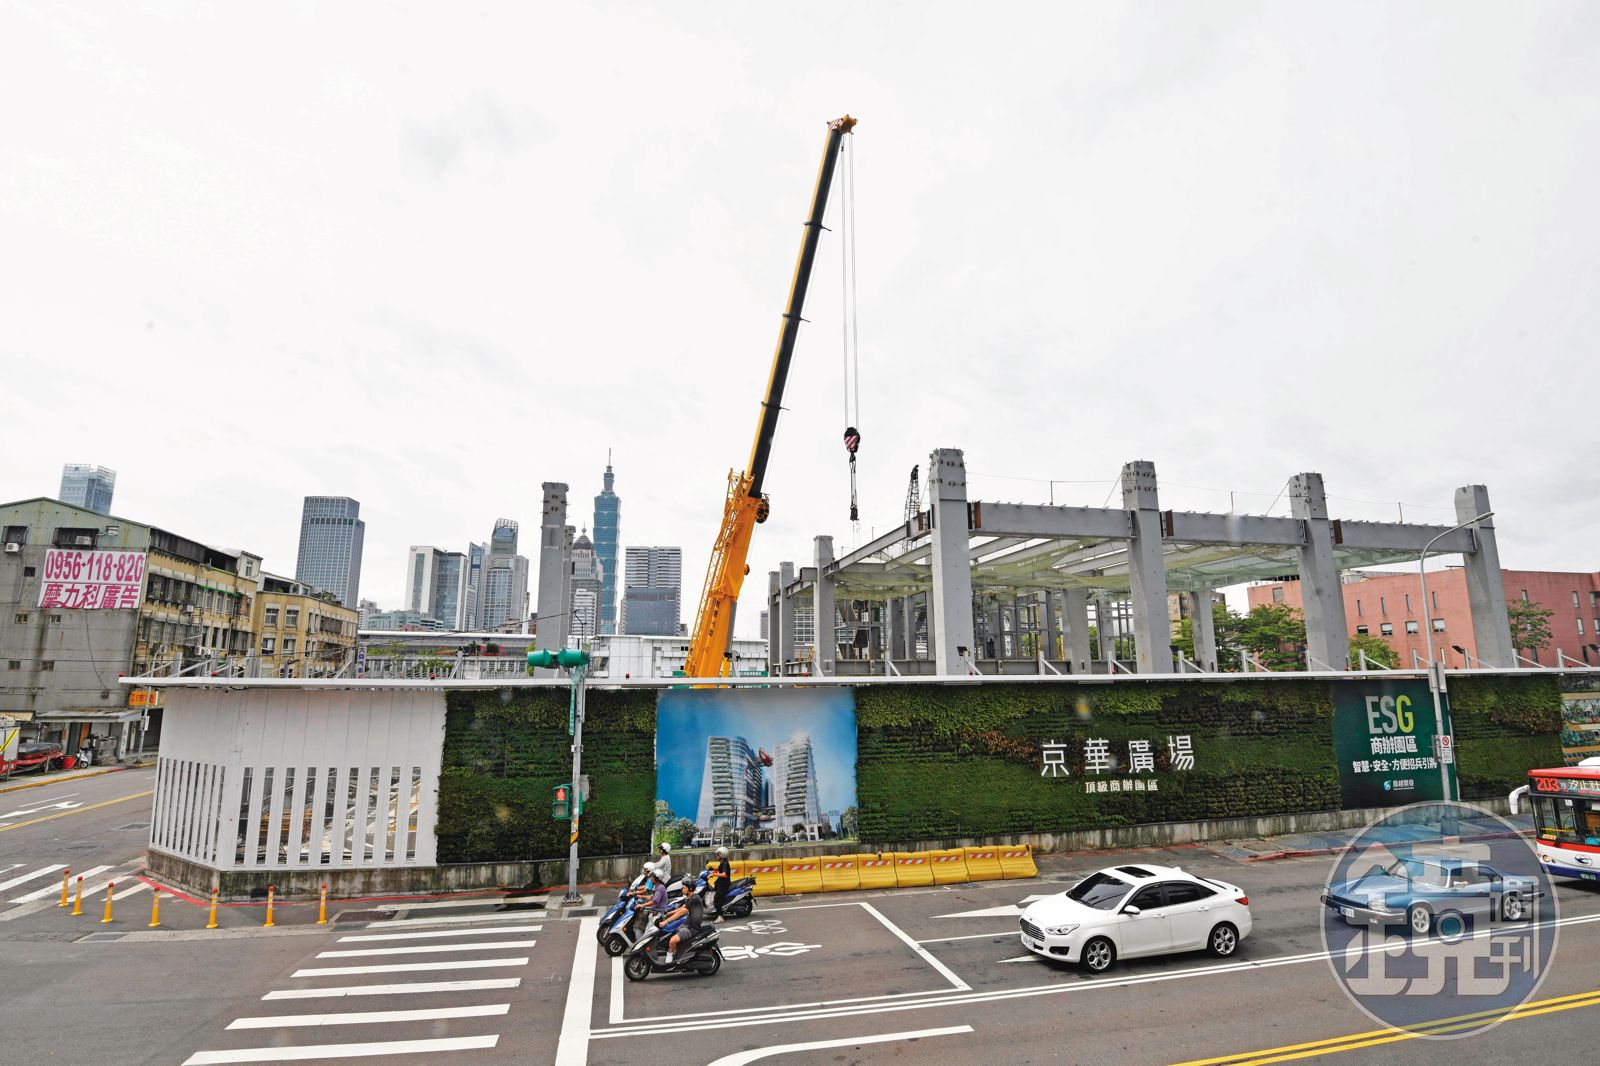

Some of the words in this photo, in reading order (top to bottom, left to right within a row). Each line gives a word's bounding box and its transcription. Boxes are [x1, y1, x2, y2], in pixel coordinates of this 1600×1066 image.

[1365, 695, 1414, 734] ESG
[1370, 735, 1418, 755] 商辦園區
[1041, 735, 1195, 777] 京華廣場
[1085, 779, 1159, 793] 頂級商辦園區
[1535, 777, 1560, 792] 203
